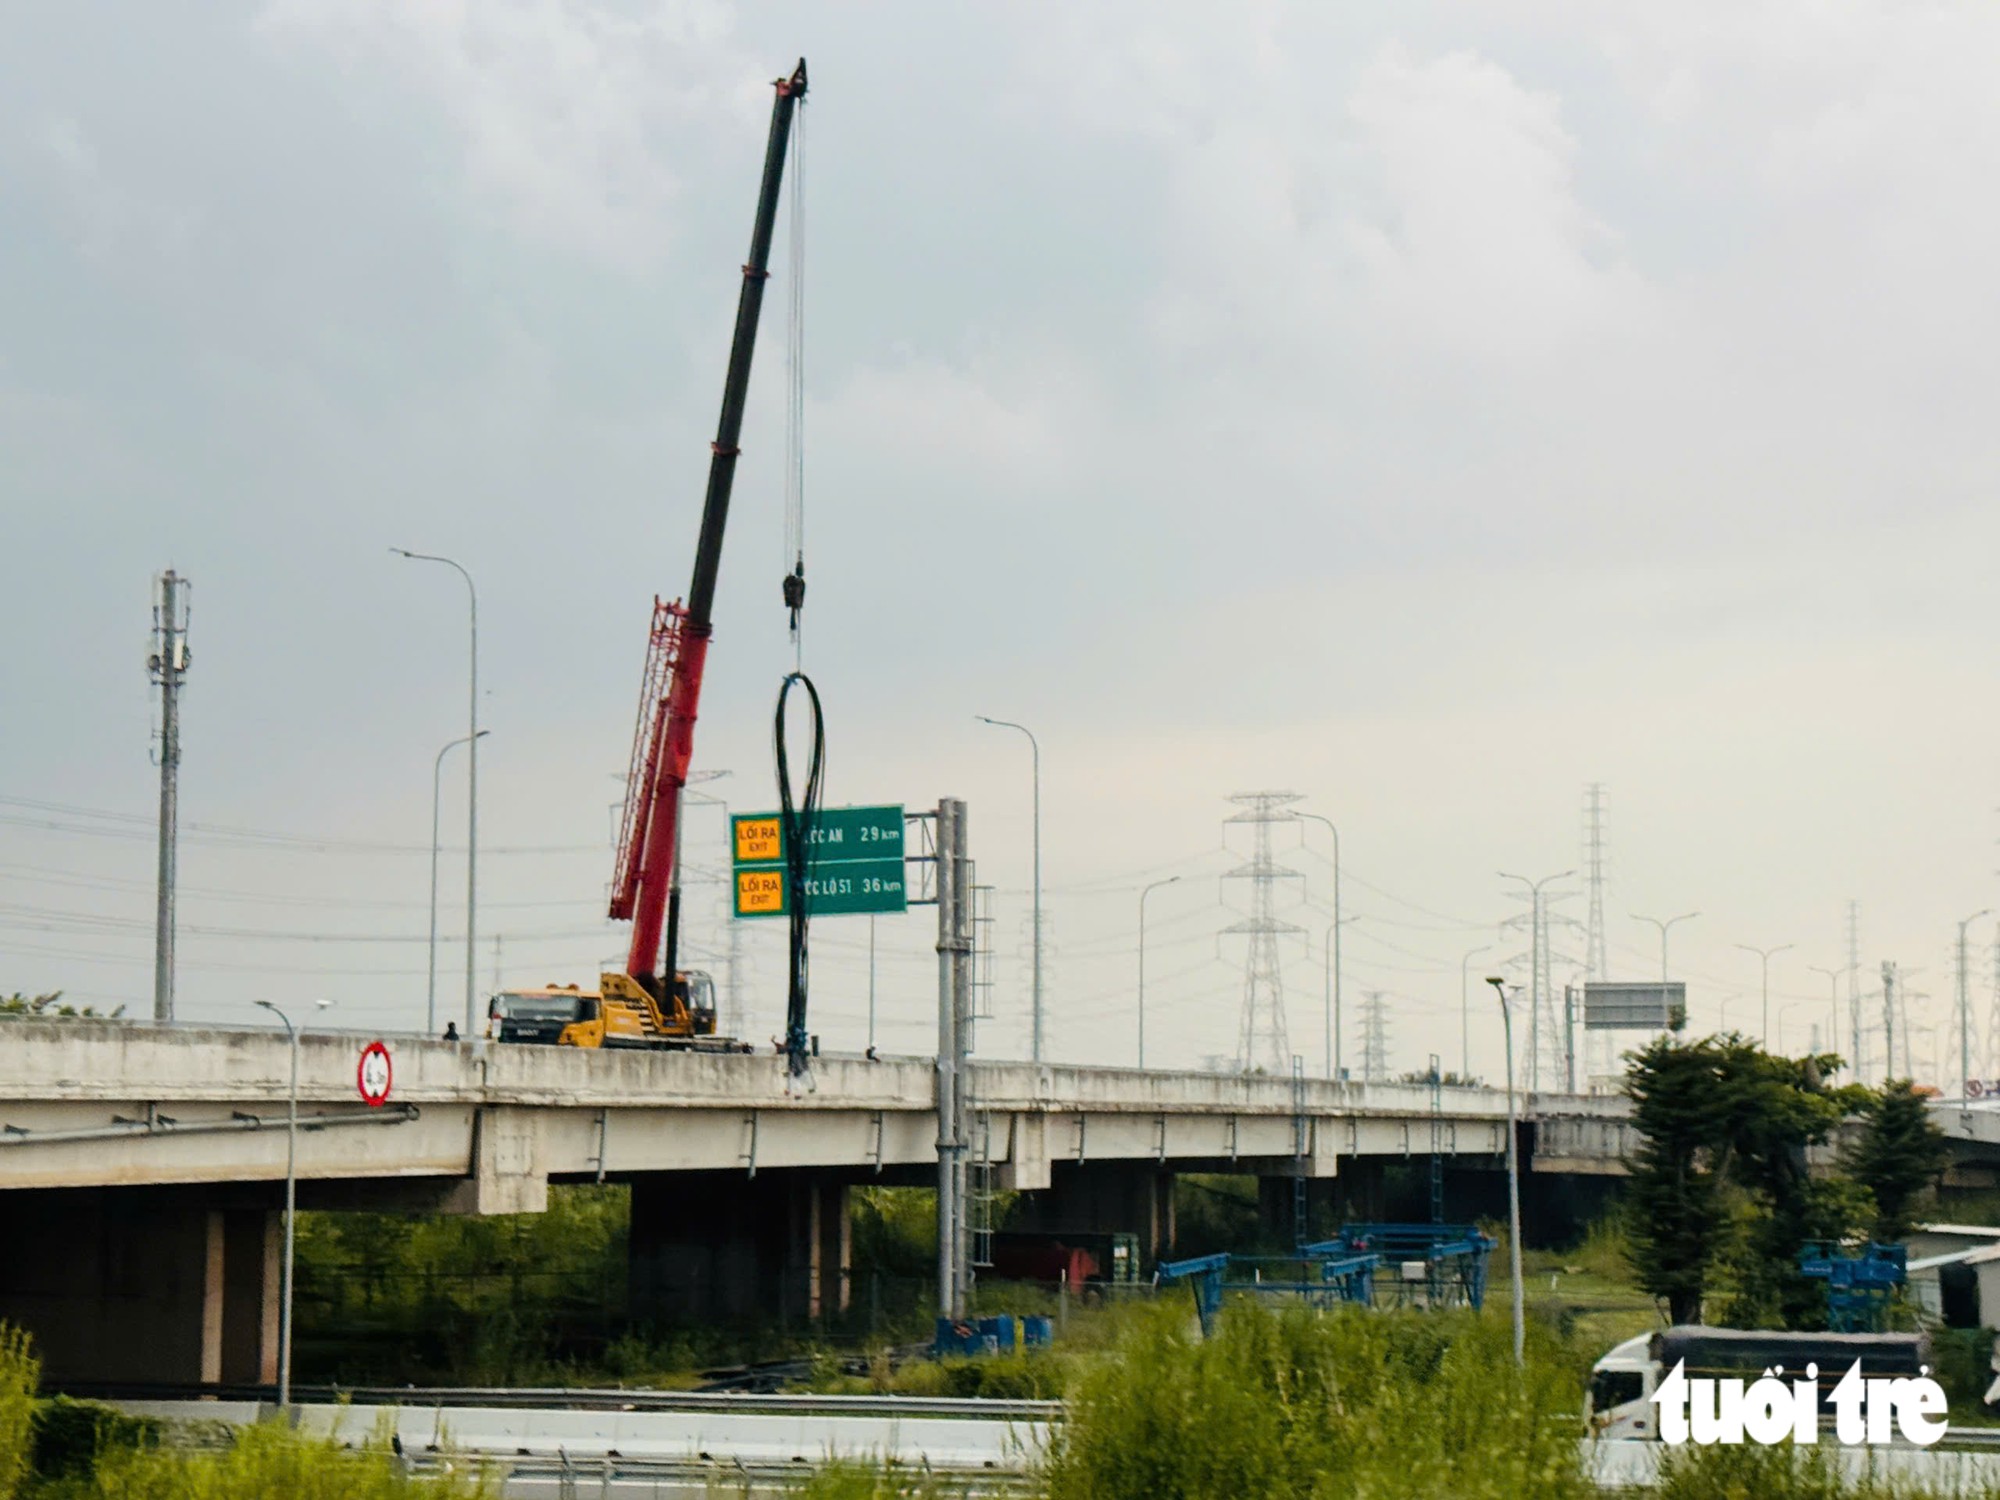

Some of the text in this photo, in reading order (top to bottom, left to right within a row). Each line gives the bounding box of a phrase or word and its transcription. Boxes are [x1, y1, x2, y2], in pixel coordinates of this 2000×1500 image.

[761, 827, 777, 839] RA
[829, 827, 843, 842] AN
[861, 826, 879, 841] 29
[881, 829, 899, 841] km
[762, 879, 778, 891] RA
[863, 877, 880, 892] 36
[883, 880, 901, 892] km
